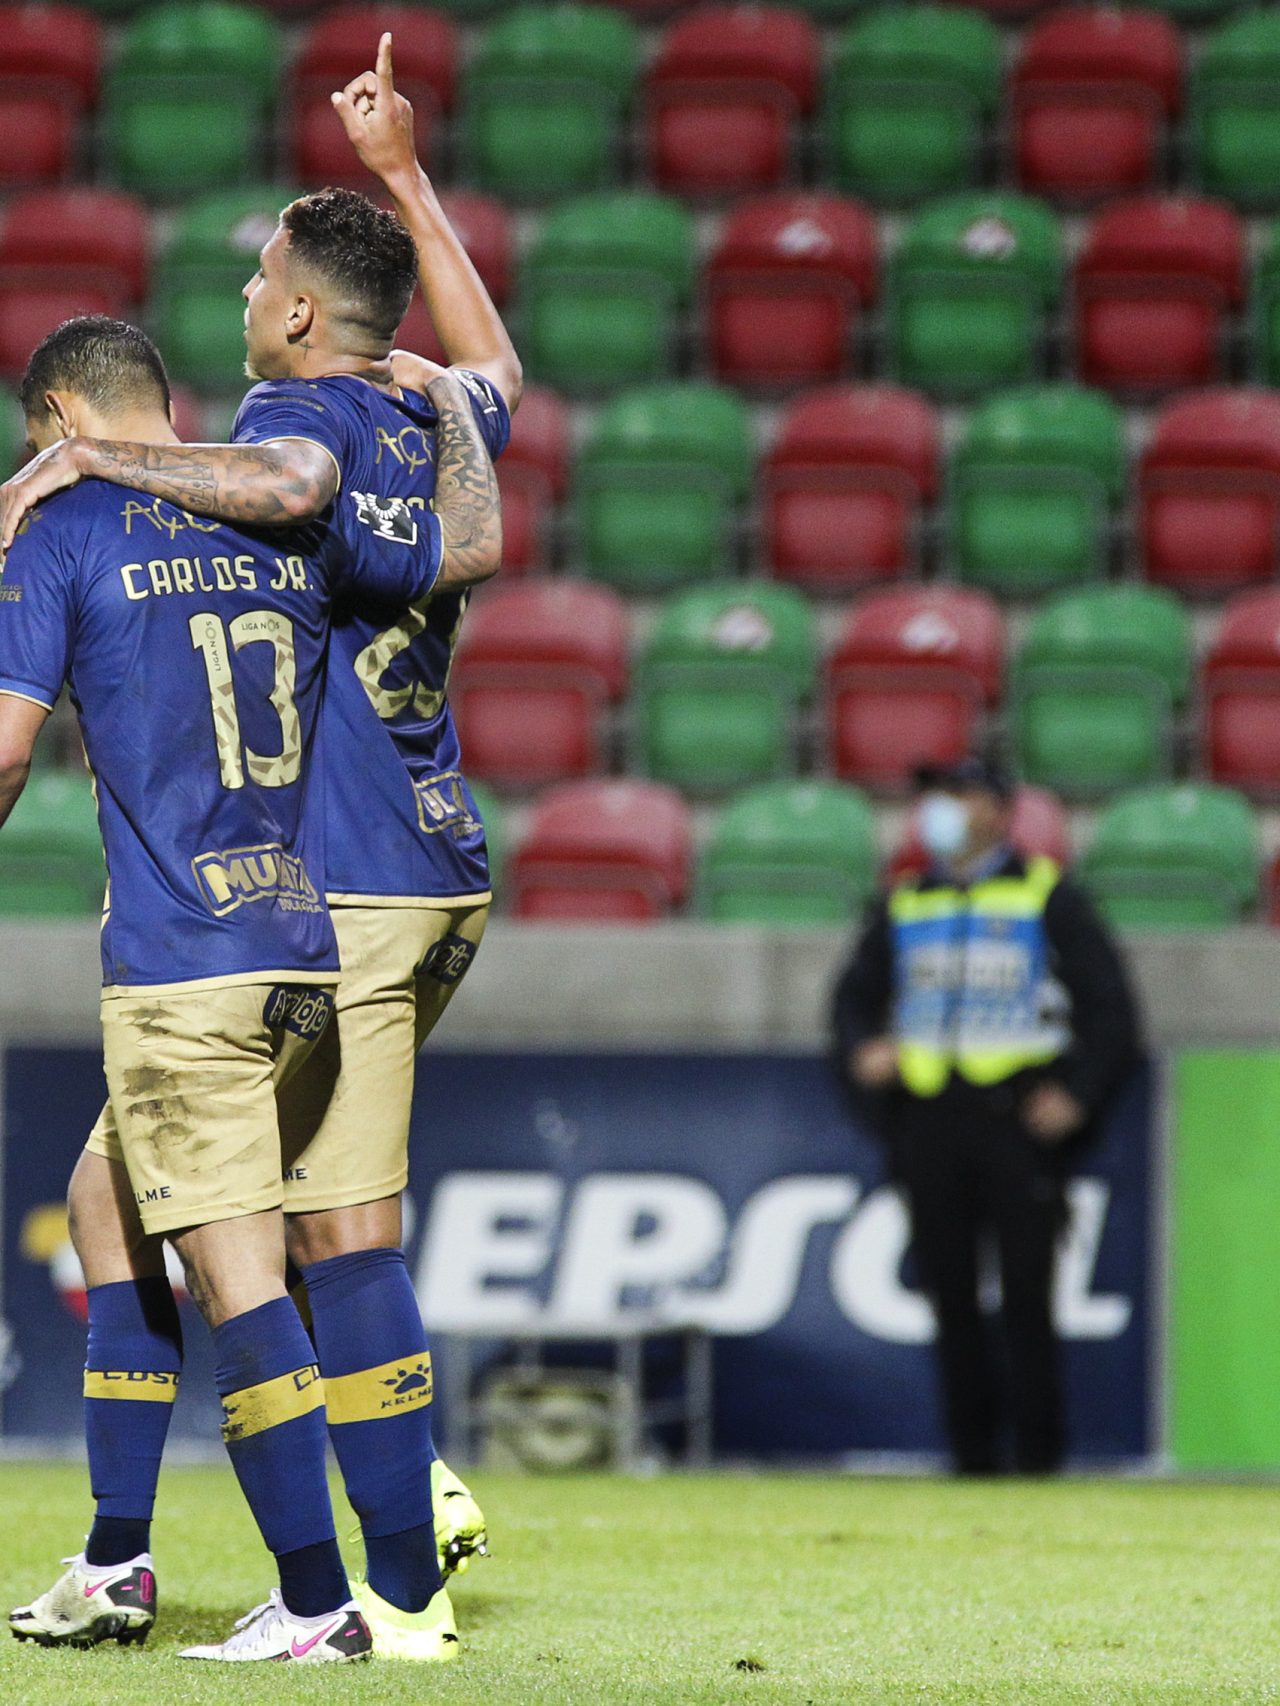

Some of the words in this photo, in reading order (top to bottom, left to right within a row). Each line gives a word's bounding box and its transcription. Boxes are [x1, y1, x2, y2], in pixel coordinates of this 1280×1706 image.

[120, 555, 258, 600] CARLOS
[270, 555, 315, 591] JR.
[241, 622, 259, 631] LIGA
[188, 609, 301, 789] 13
